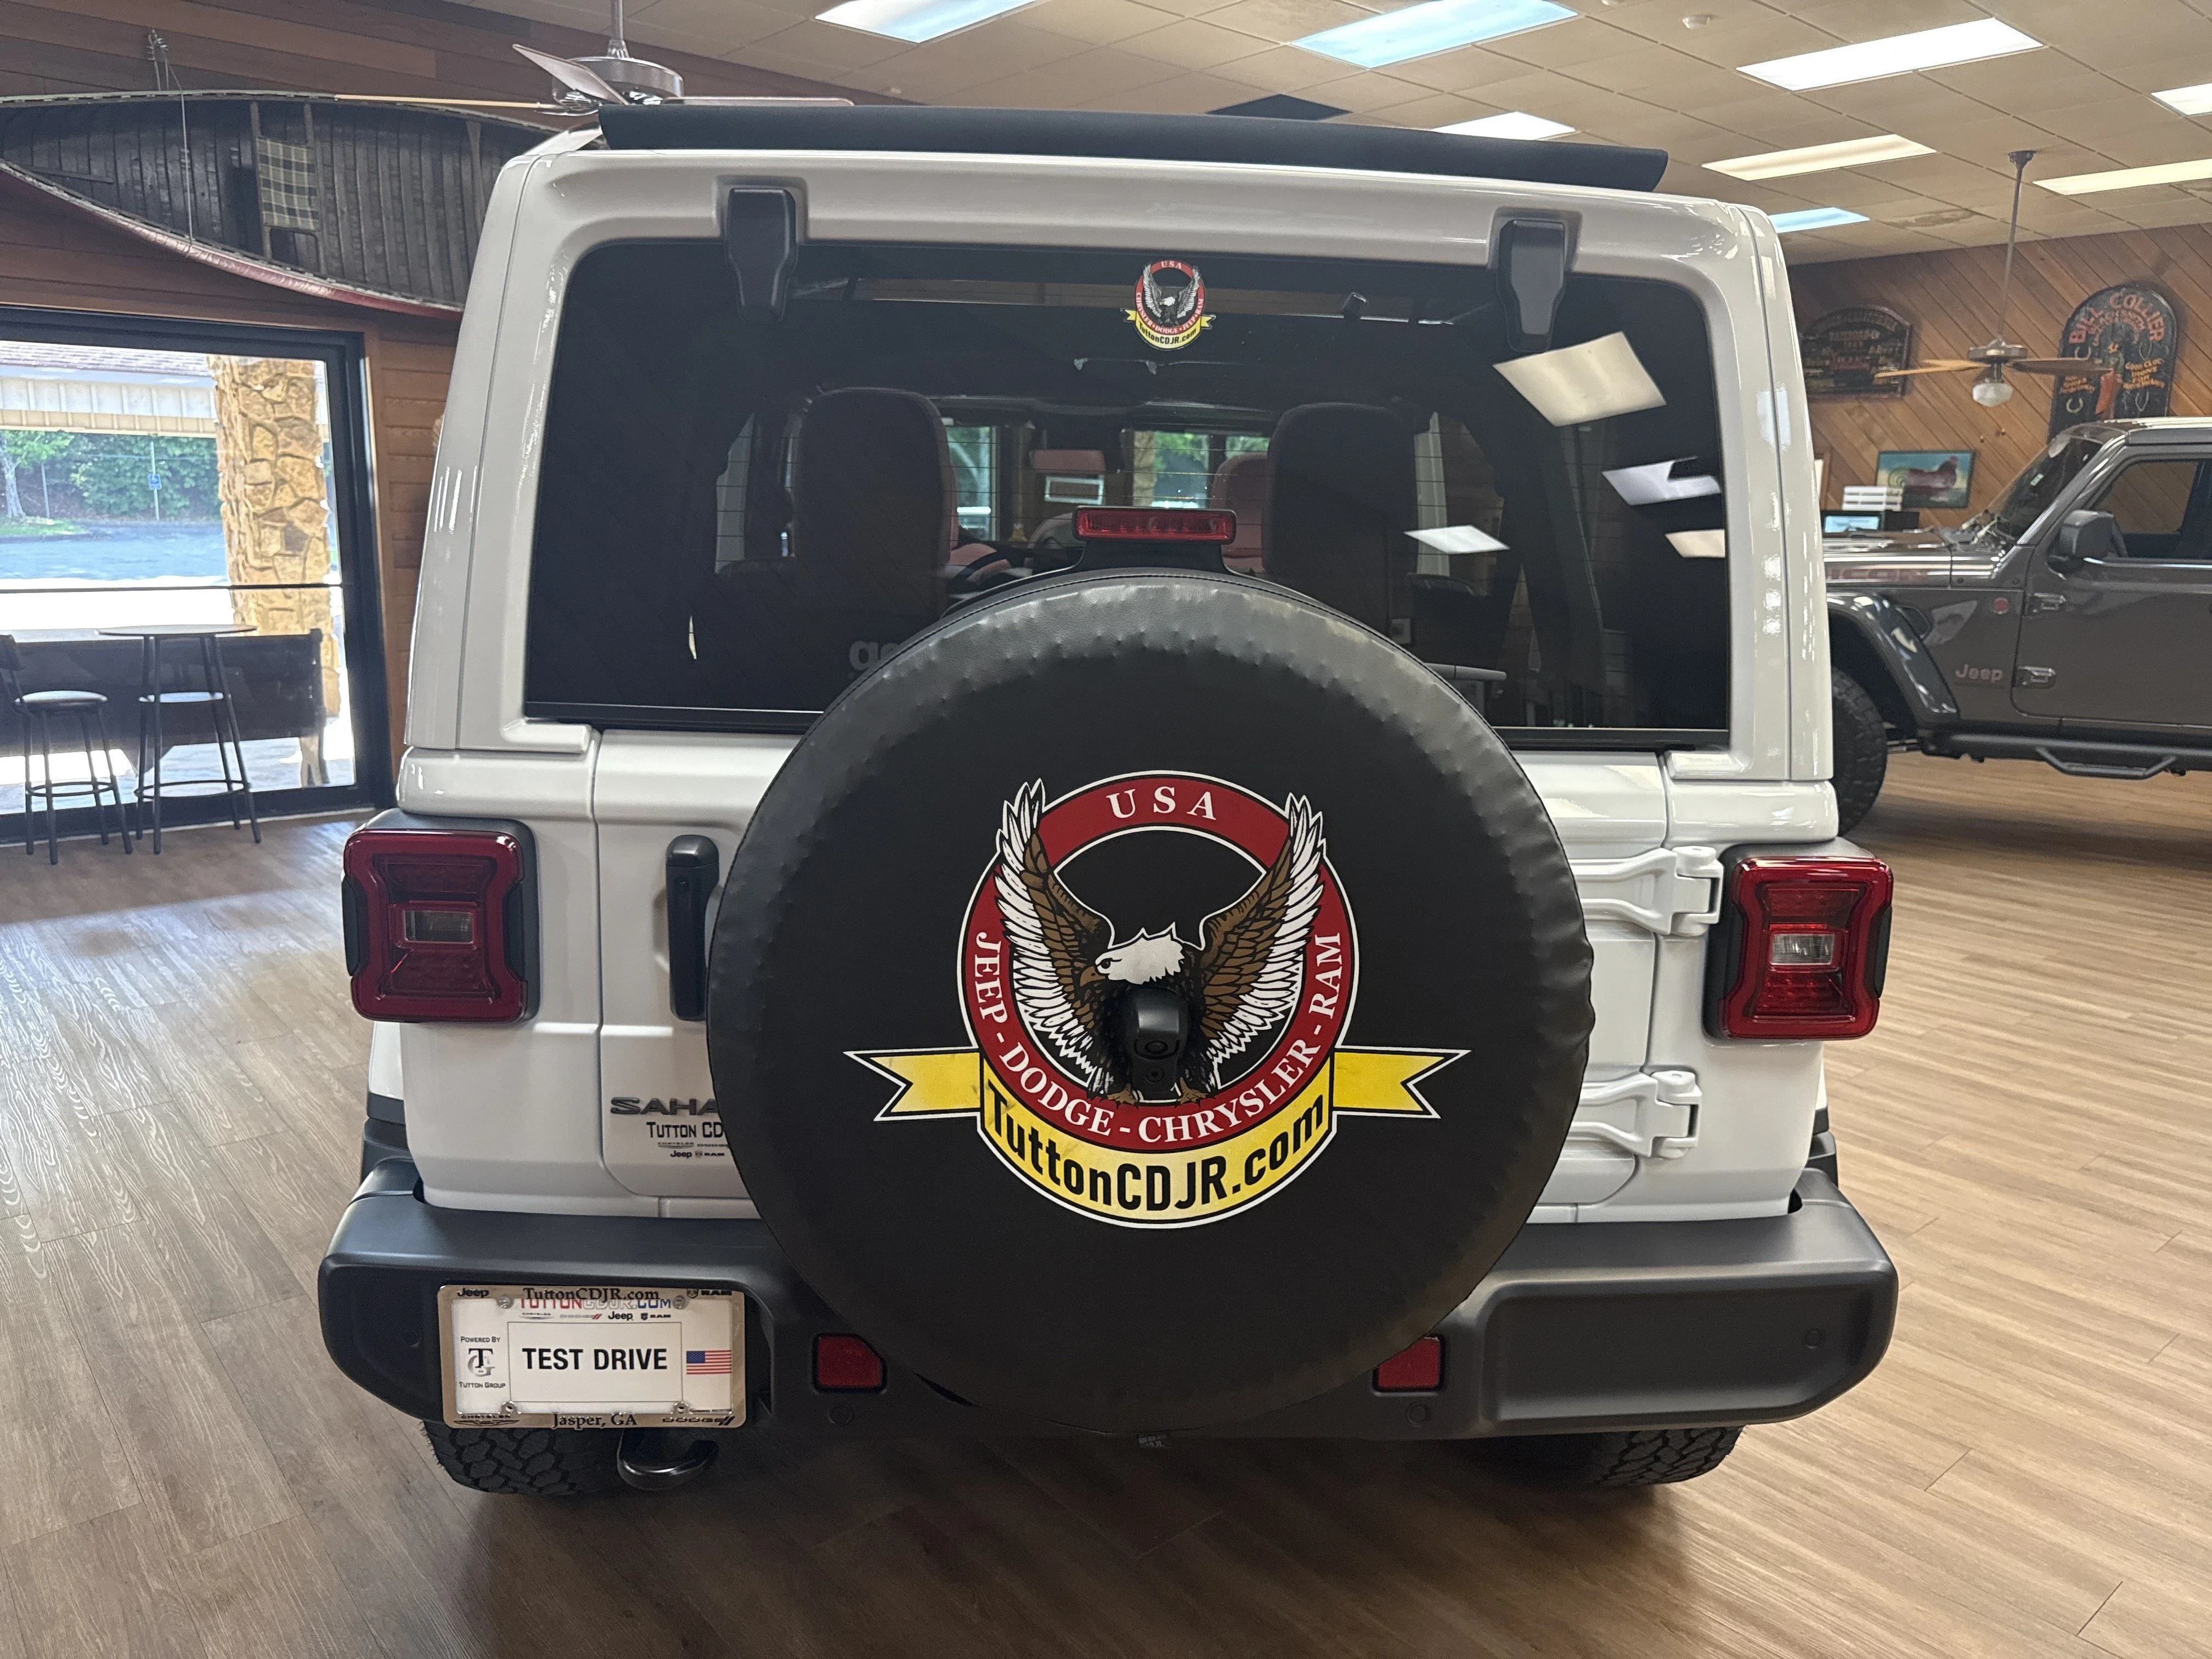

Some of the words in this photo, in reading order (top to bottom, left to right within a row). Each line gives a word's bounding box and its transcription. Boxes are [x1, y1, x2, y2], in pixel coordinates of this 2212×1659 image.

[1161, 260, 1182, 269] USA
[1155, 325, 1178, 334] DODGE
[1183, 316, 1196, 330] JEEP
[2069, 307, 2104, 344] BILL
[2109, 292, 2165, 341] COLLIER
[1138, 320, 1197, 345] TuttonCDJR.com
[1955, 664, 2003, 682] Jeep
[1106, 786, 1216, 821] USA
[974, 932, 1008, 1024] JEEP
[999, 1042, 1115, 1137] DODGE
[1138, 1039, 1321, 1143] CHRYSLER
[1308, 932, 1342, 1019] RAM
[987, 1078, 1323, 1211] TuttonCDJR.com
[670, 1150, 692, 1159] Jeep
[456, 1288, 490, 1299] Jeep
[523, 1288, 661, 1303] TuttonCDJR.com
[607, 1311, 634, 1321] Jeep
[522, 1347, 583, 1370] TEST
[594, 1348, 668, 1370] DRIVE
[550, 1412, 606, 1430] Jasper,
[611, 1413, 638, 1426] GA
